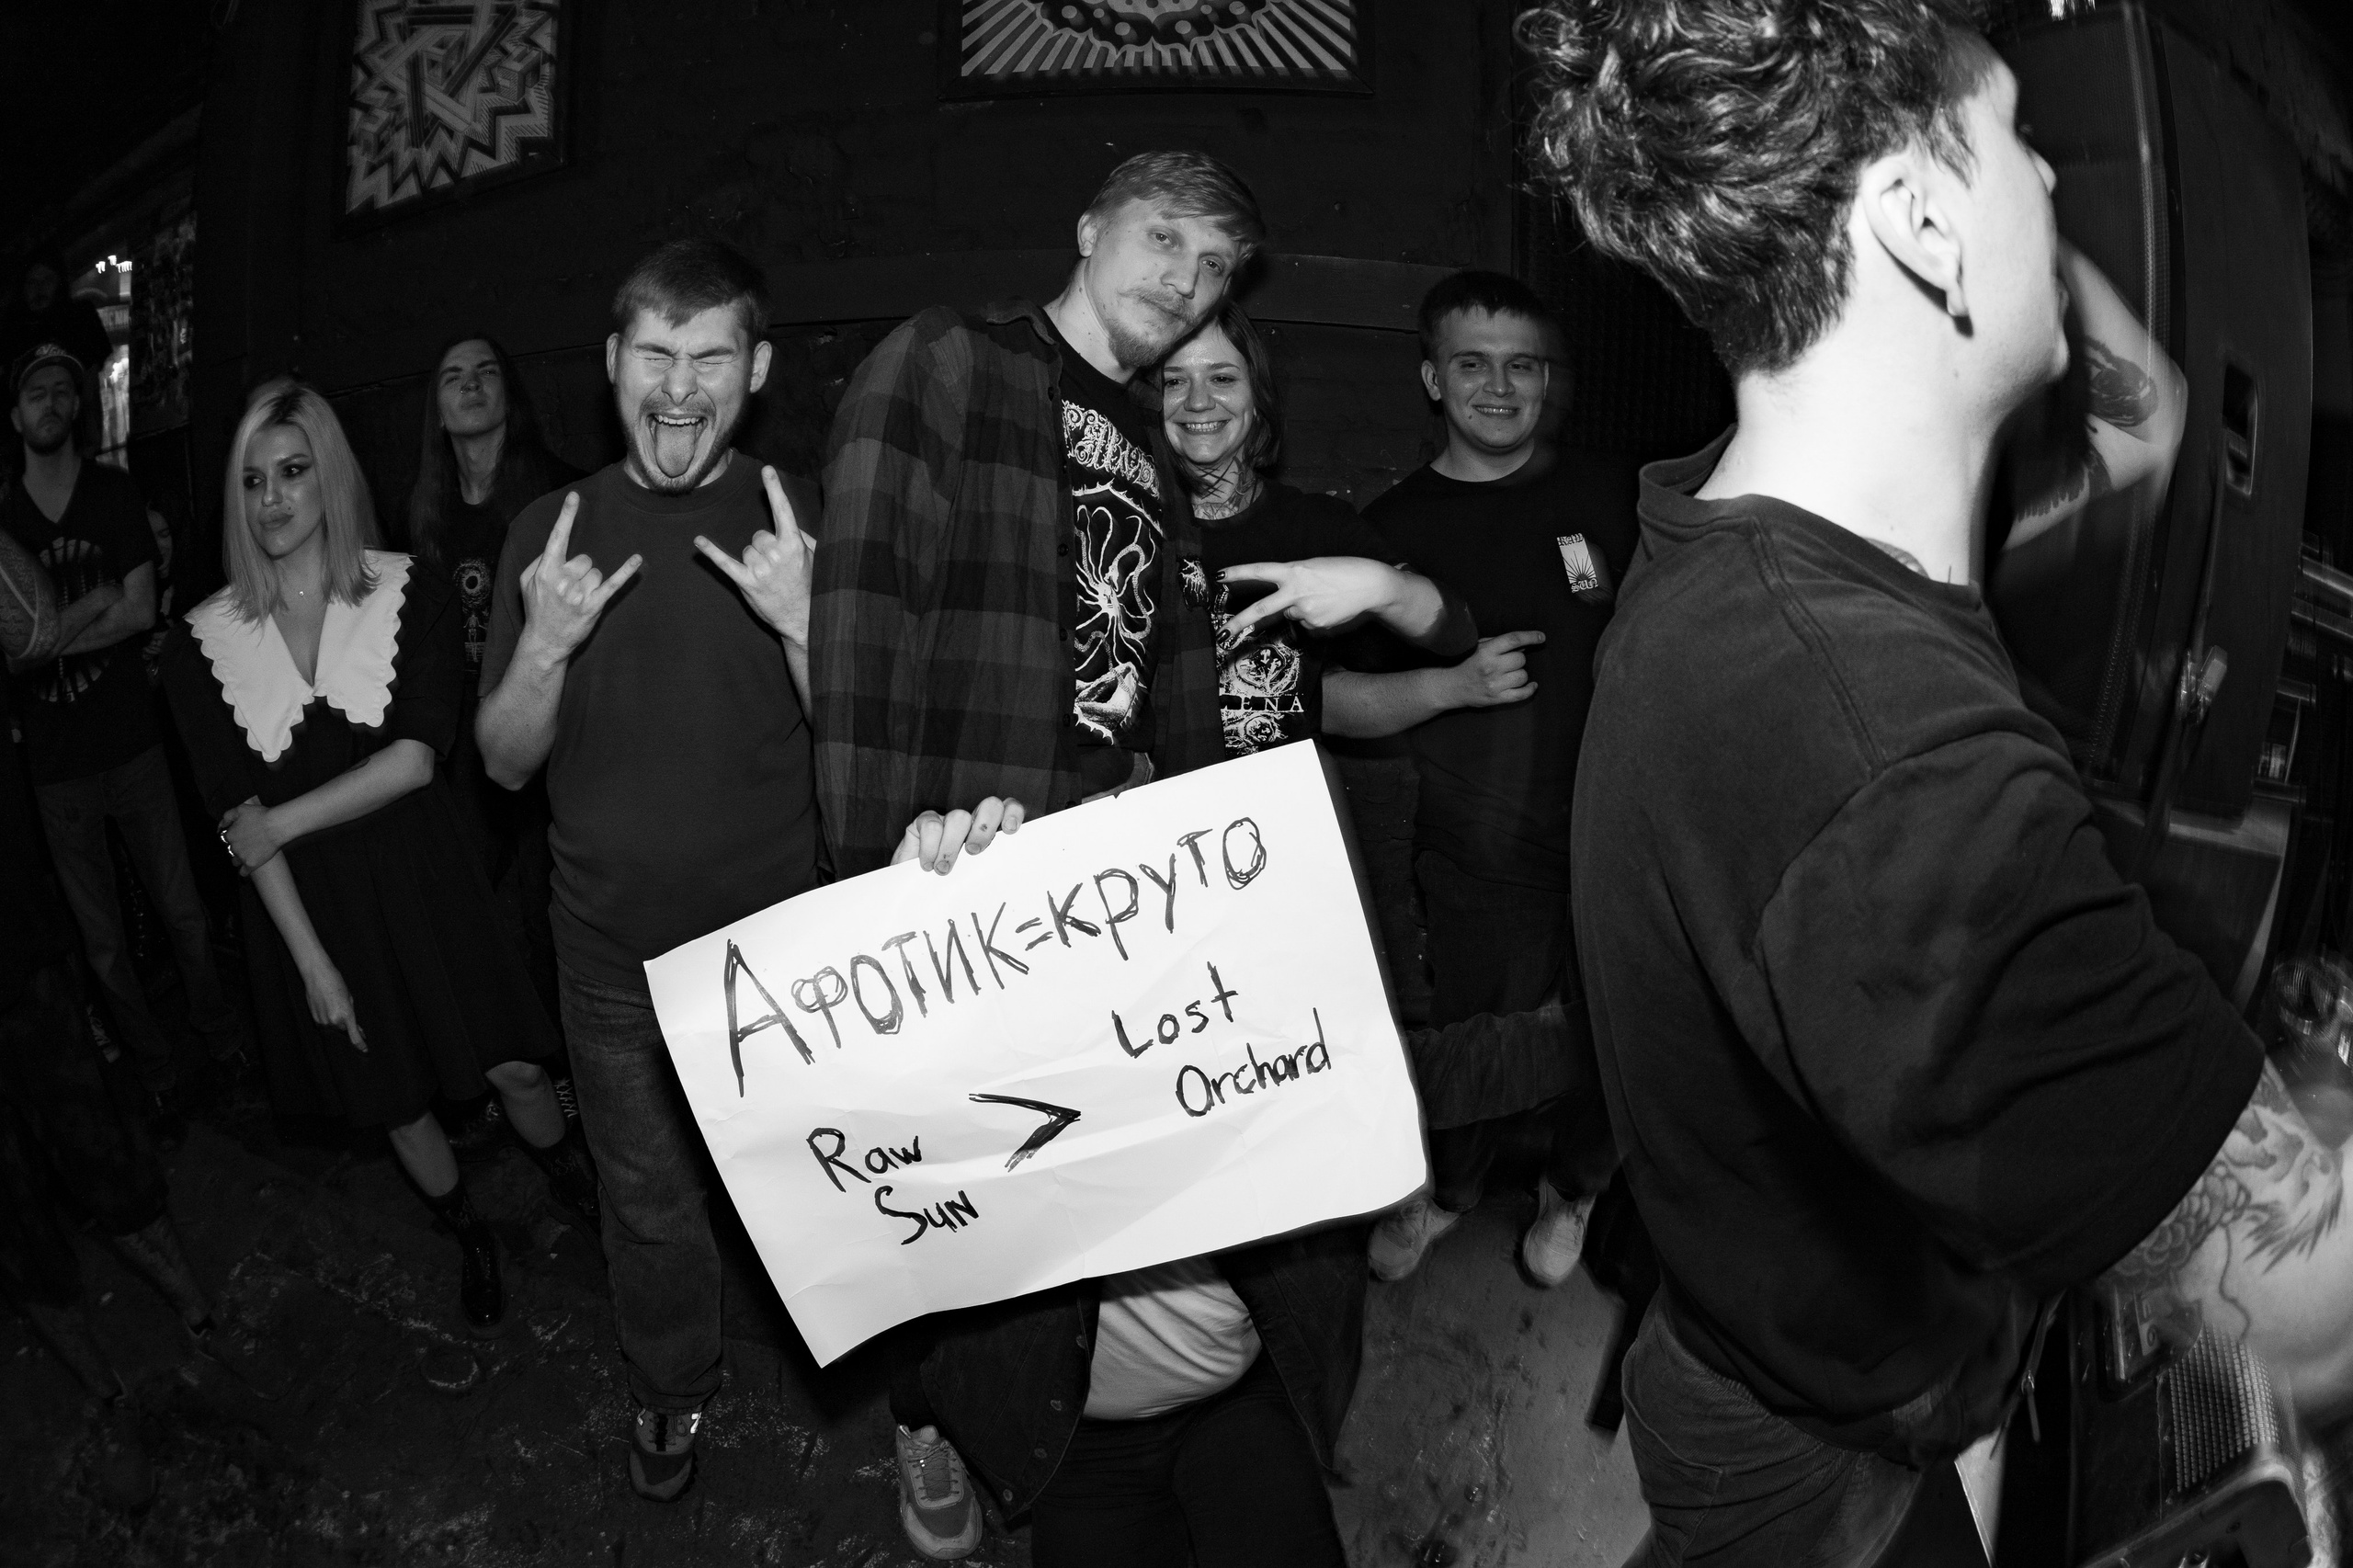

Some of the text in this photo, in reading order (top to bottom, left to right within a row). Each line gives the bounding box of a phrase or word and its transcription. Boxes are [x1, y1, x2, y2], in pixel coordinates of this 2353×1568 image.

[1221, 696, 1304, 713] ENA
[1110, 960, 1239, 1061] Lost
[1175, 1007, 1333, 1119] Orchard
[805, 1126, 923, 1195] Raw
[874, 1185, 981, 1247] Sun
